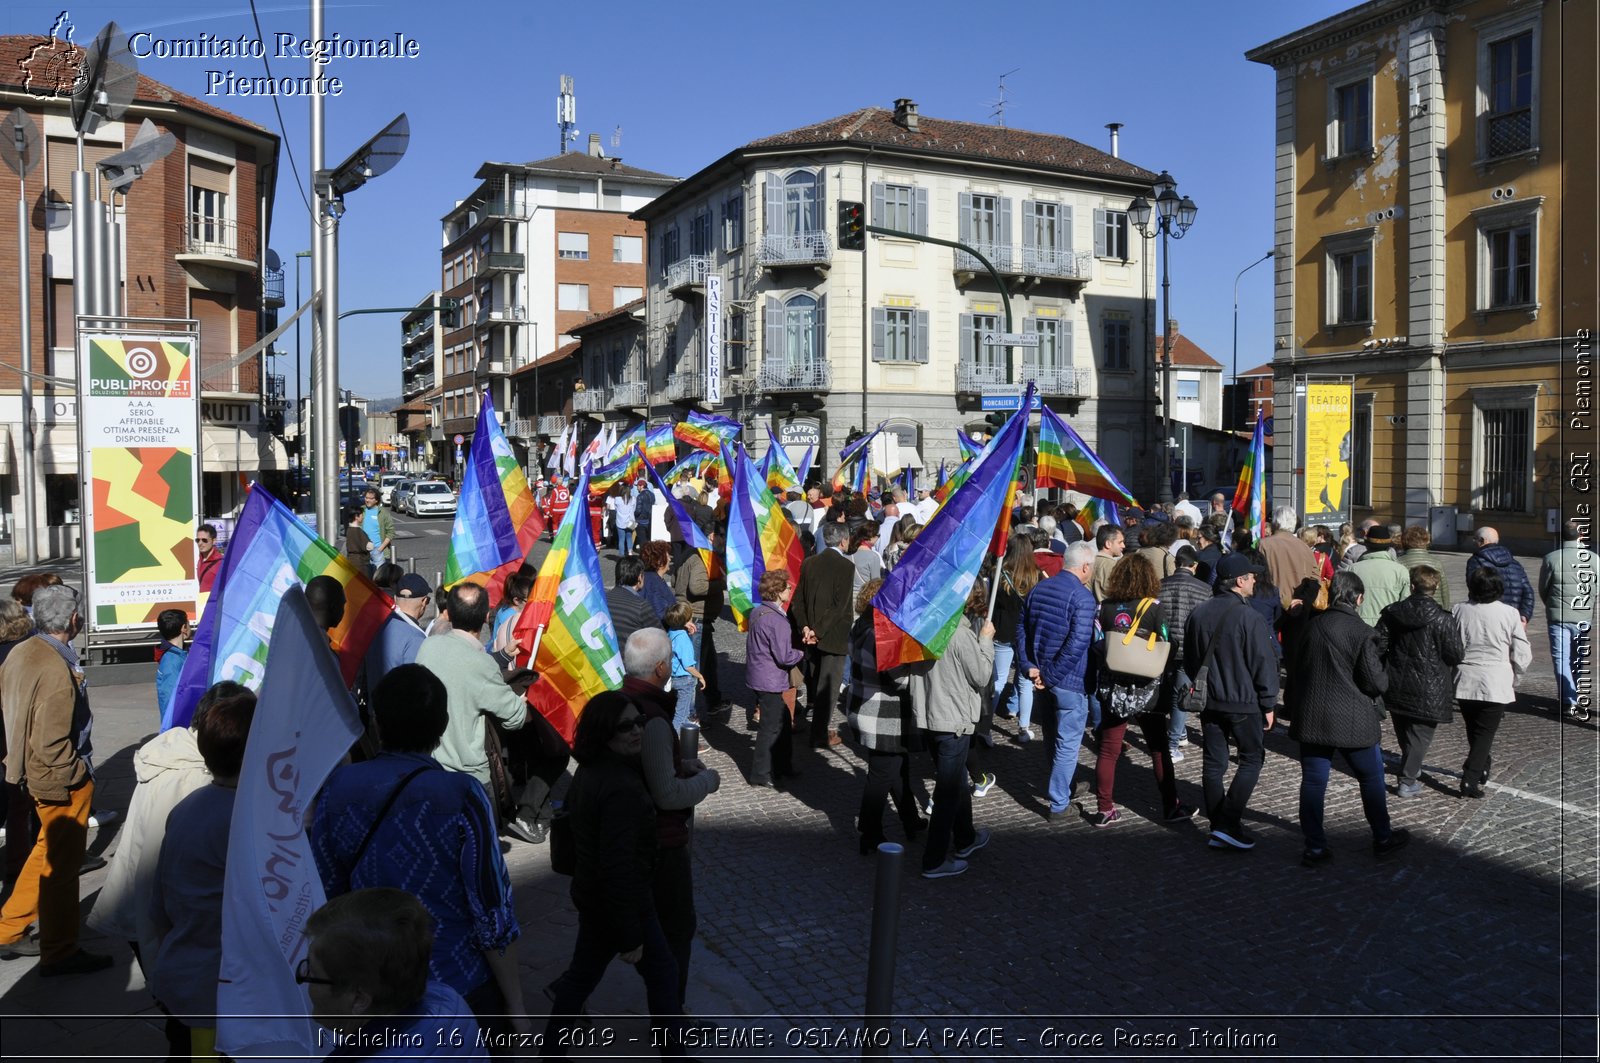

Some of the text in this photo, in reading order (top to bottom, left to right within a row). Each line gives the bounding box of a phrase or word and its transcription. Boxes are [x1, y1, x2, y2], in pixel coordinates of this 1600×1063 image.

[709, 280, 719, 400] PASTICCERIA
[91, 379, 189, 391] PUBLIPROGET
[1310, 395, 1348, 405] TEATRO
[781, 435, 819, 444] BLANCO
[146, 588, 173, 596] 34902
